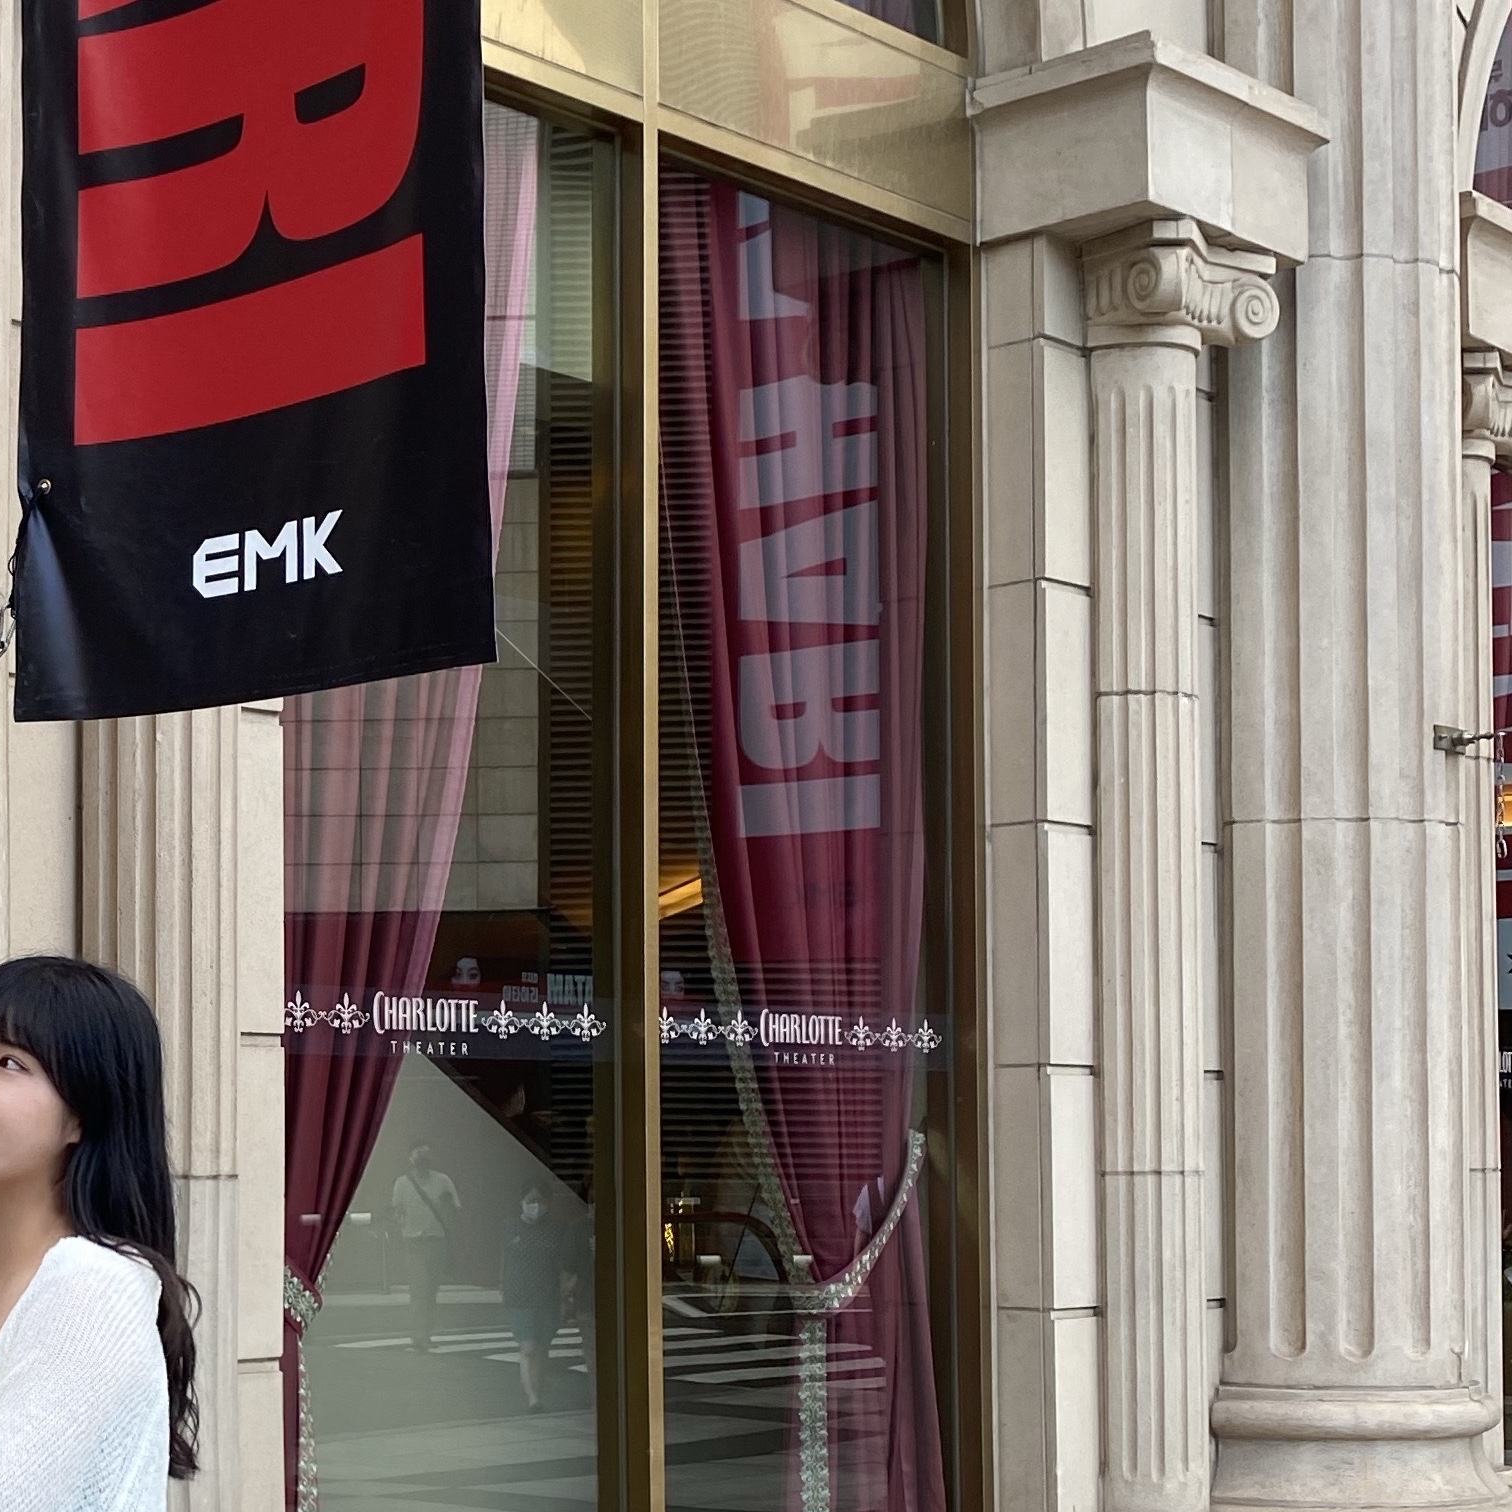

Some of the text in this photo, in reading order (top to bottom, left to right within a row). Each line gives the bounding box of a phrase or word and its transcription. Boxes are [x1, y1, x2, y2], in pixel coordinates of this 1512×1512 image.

[74, 0, 426, 446] RI
[192, 509, 343, 599] EMK
[373, 990, 479, 1035] CHARLOTTE
[759, 1008, 843, 1047] CHARLOTTE
[390, 1040, 469, 1056] THEATER
[773, 1051, 835, 1066] THEATER
